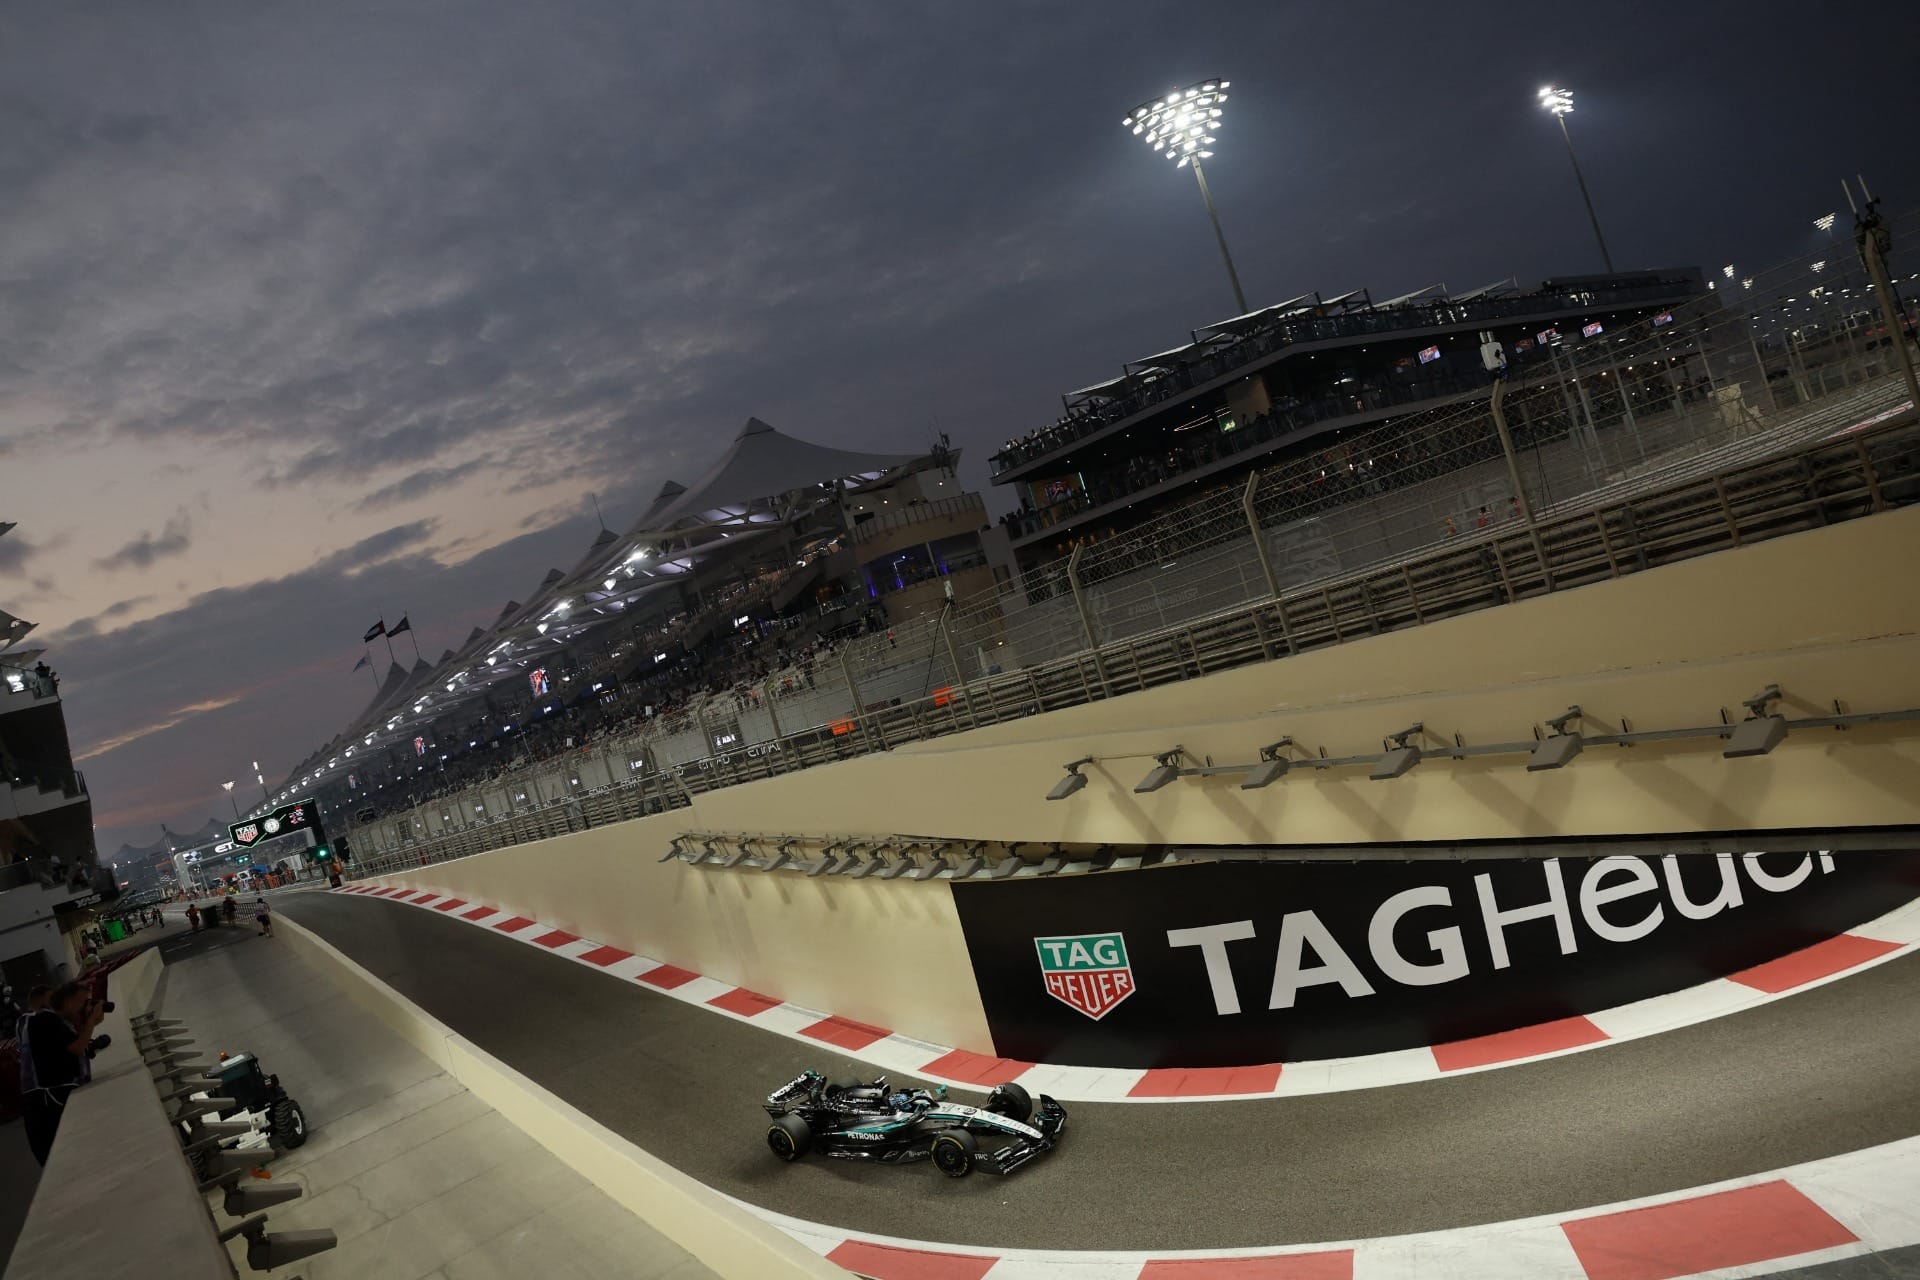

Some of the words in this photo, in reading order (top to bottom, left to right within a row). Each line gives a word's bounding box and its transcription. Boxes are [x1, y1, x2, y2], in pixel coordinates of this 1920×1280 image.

[1043, 939, 1120, 967] TAG
[1049, 972, 1129, 1014] HEUER
[847, 1132, 886, 1141] PETRONAS
[974, 1153, 988, 1161] IWC
